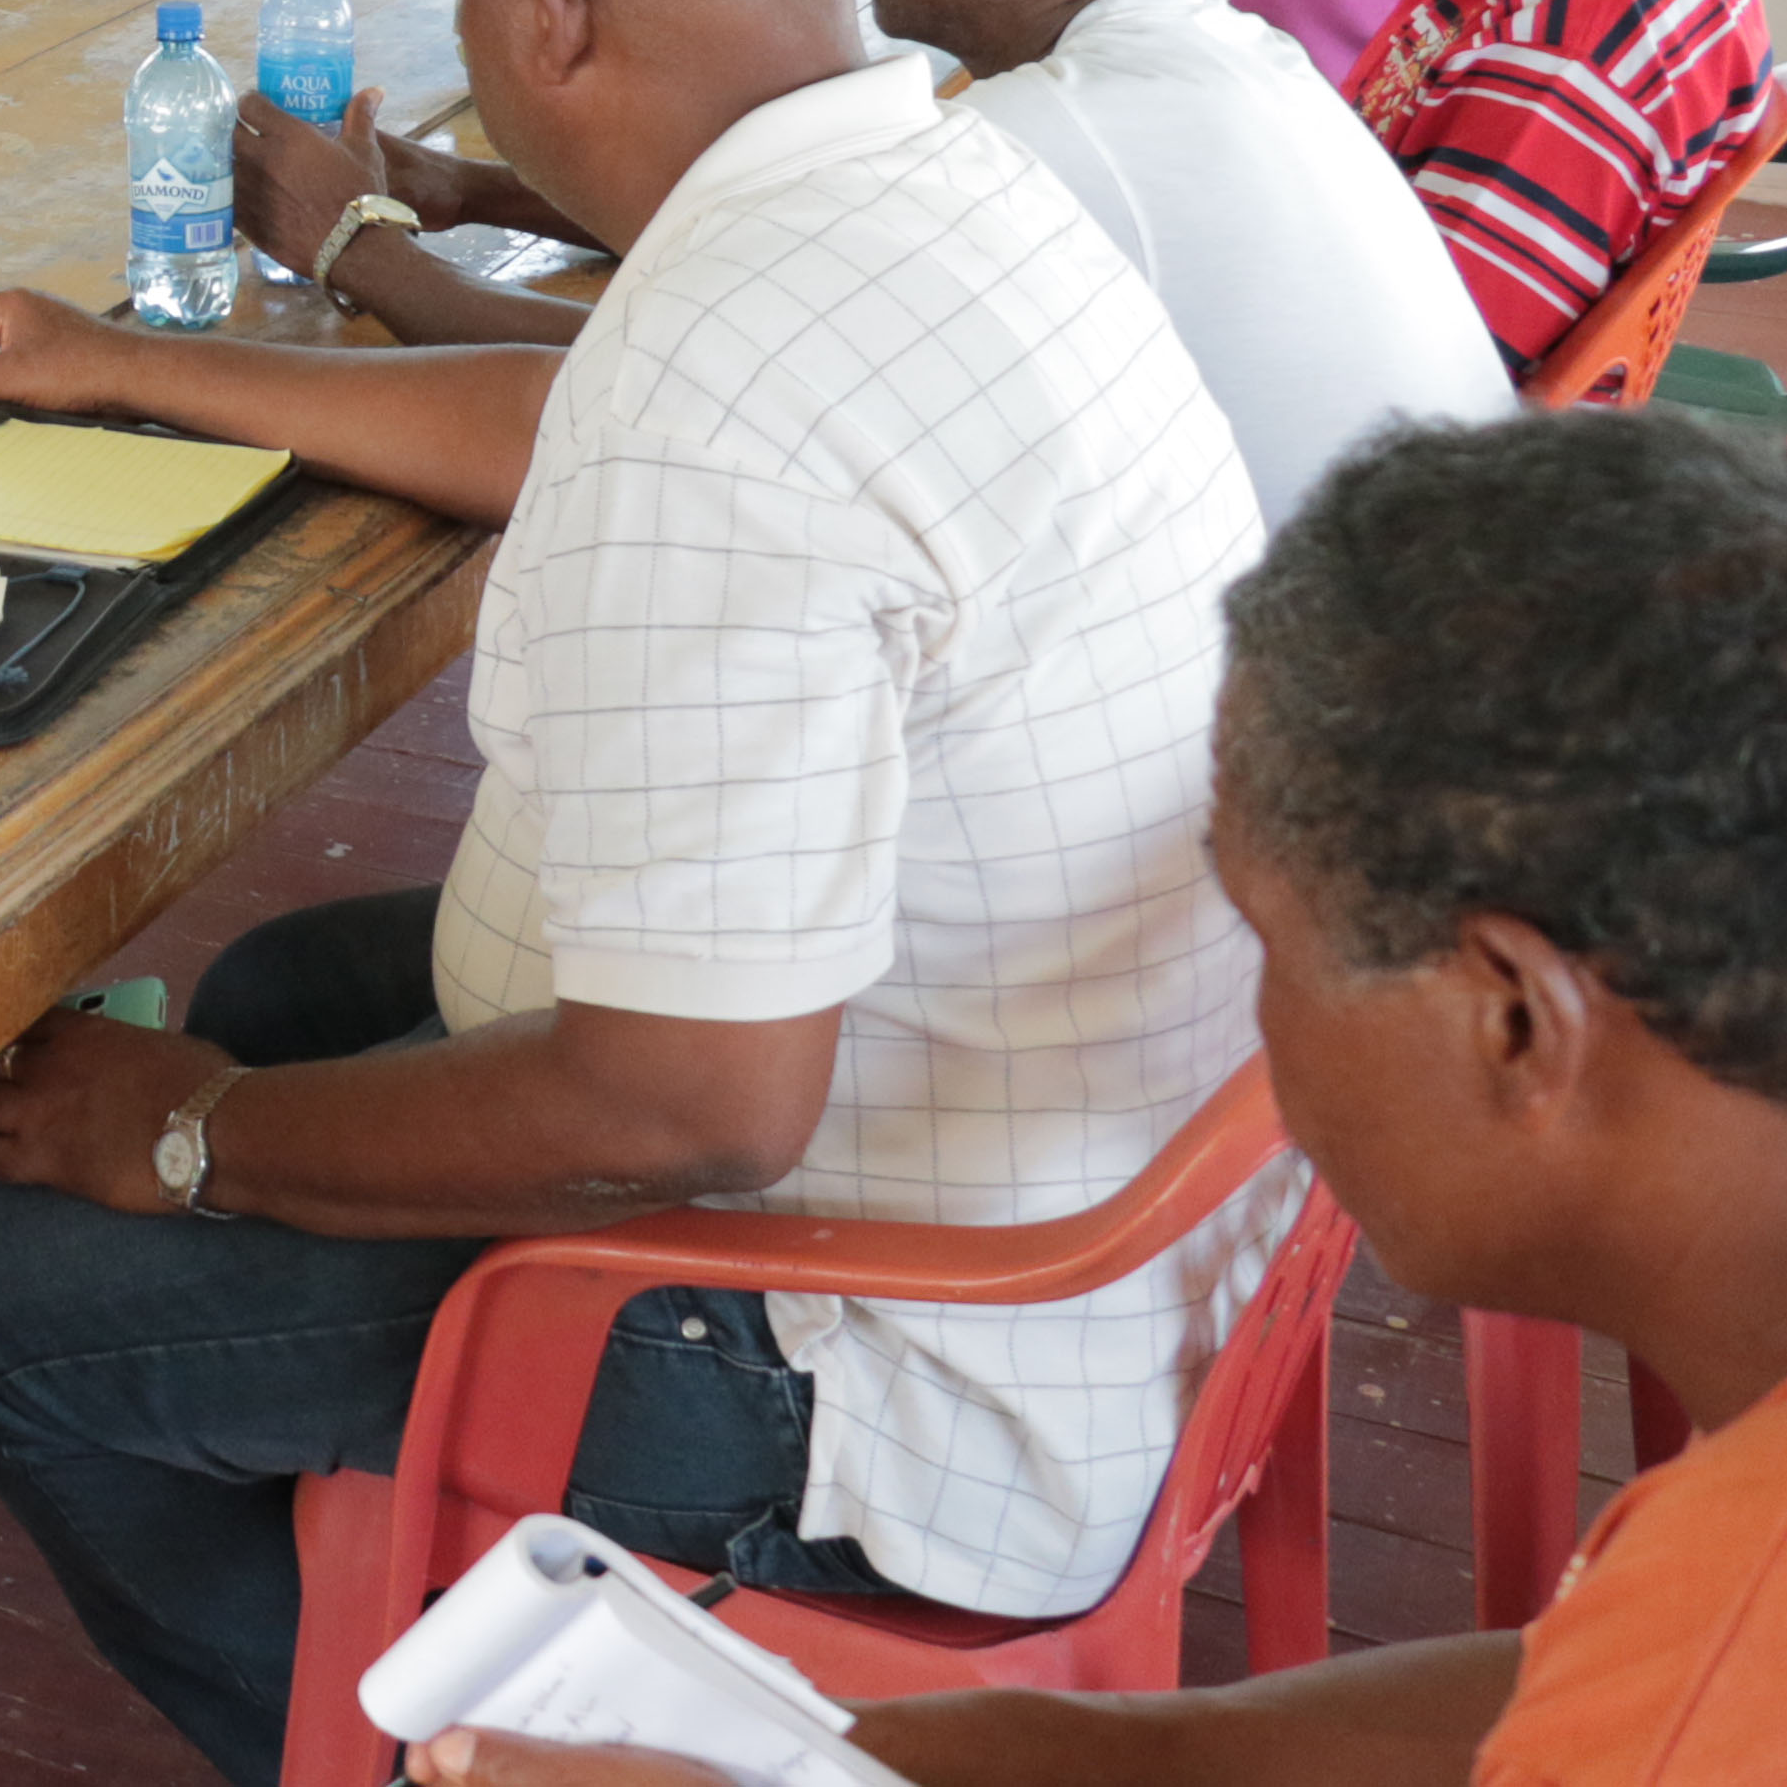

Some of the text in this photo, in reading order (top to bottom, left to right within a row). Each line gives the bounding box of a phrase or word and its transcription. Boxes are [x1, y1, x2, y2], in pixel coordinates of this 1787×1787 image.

[281, 74, 332, 94] AQUA
[284, 94, 328, 110] MIST
[132, 185, 205, 201] DIAMOND
